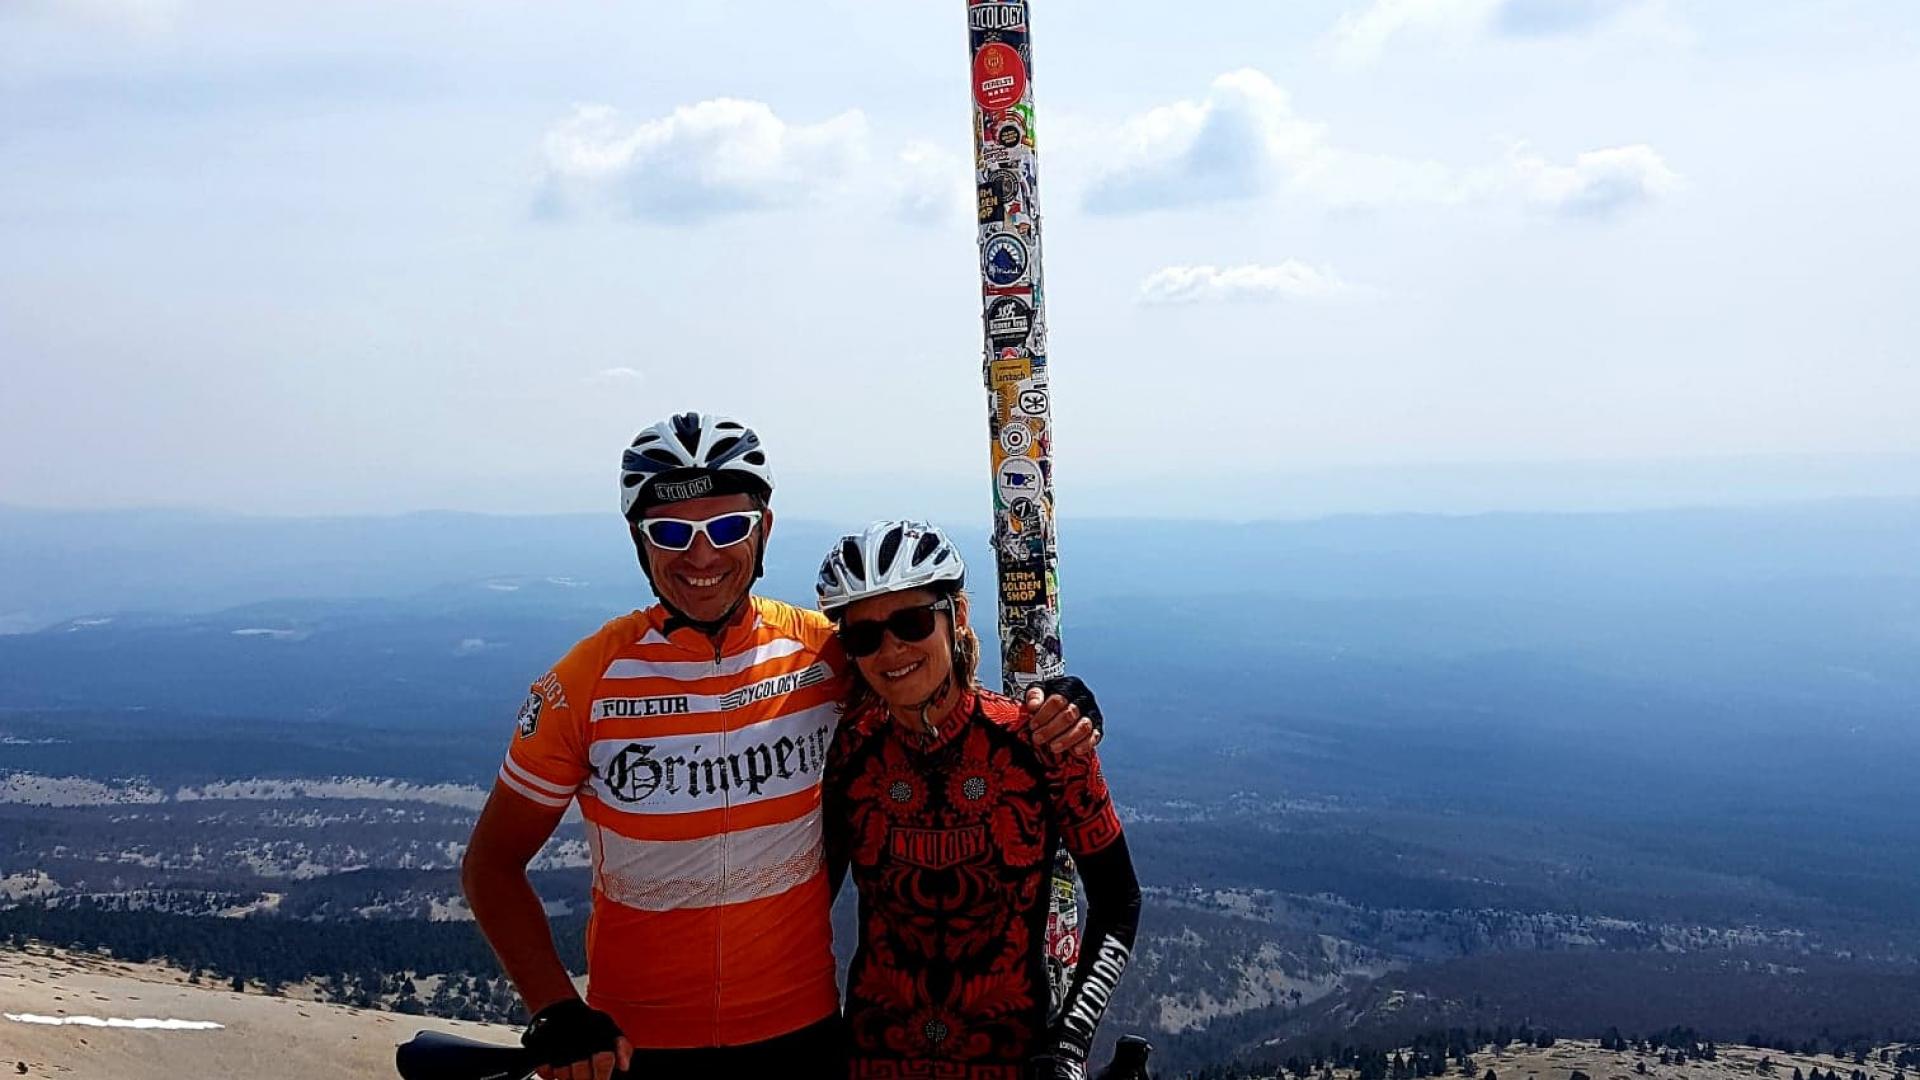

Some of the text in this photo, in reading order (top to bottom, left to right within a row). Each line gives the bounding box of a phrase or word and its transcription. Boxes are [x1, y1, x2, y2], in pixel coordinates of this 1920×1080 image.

[970, 6, 1022, 28] CYCOLOGY
[657, 478, 708, 500] CYCOLOGY
[1004, 571, 1036, 581] TEAM
[1006, 590, 1036, 601] SHOP
[737, 673, 800, 706] CYCOLOGY
[604, 724, 829, 803] Grimpeur
[892, 825, 983, 866] CYCOLOGY
[1063, 933, 1131, 1038] CYCOLOGY
